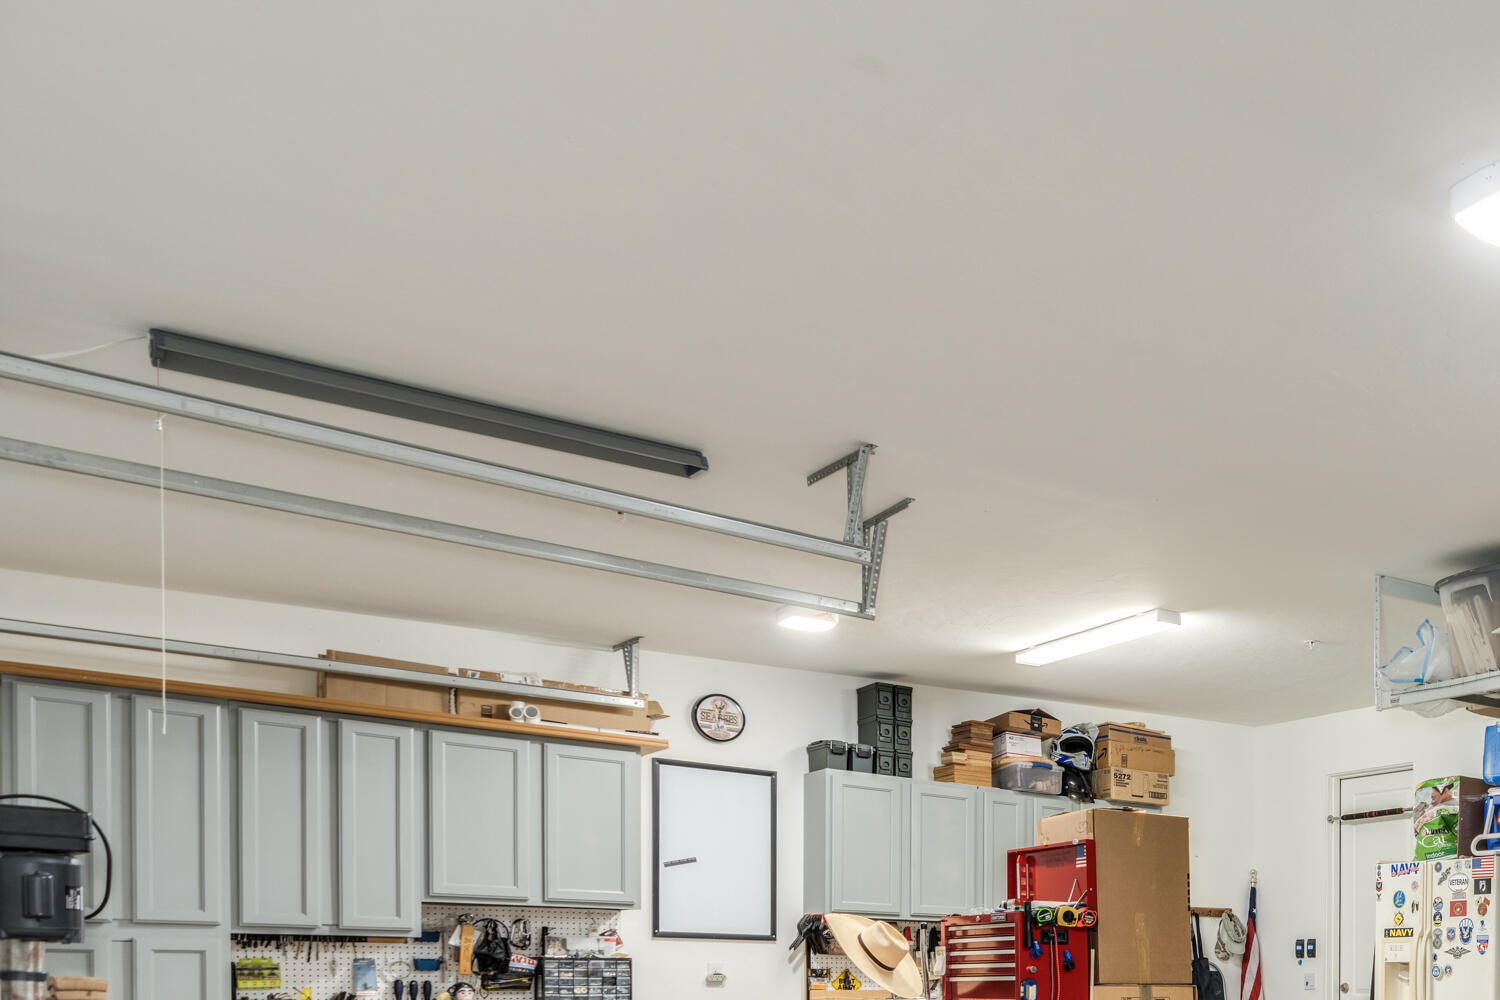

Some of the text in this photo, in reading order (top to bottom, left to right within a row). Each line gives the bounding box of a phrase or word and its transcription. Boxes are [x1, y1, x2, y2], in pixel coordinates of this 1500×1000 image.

[1113, 772, 1132, 781] 5272
[1391, 862, 1420, 877] NAVY
[1389, 929, 1413, 937] NAVY
